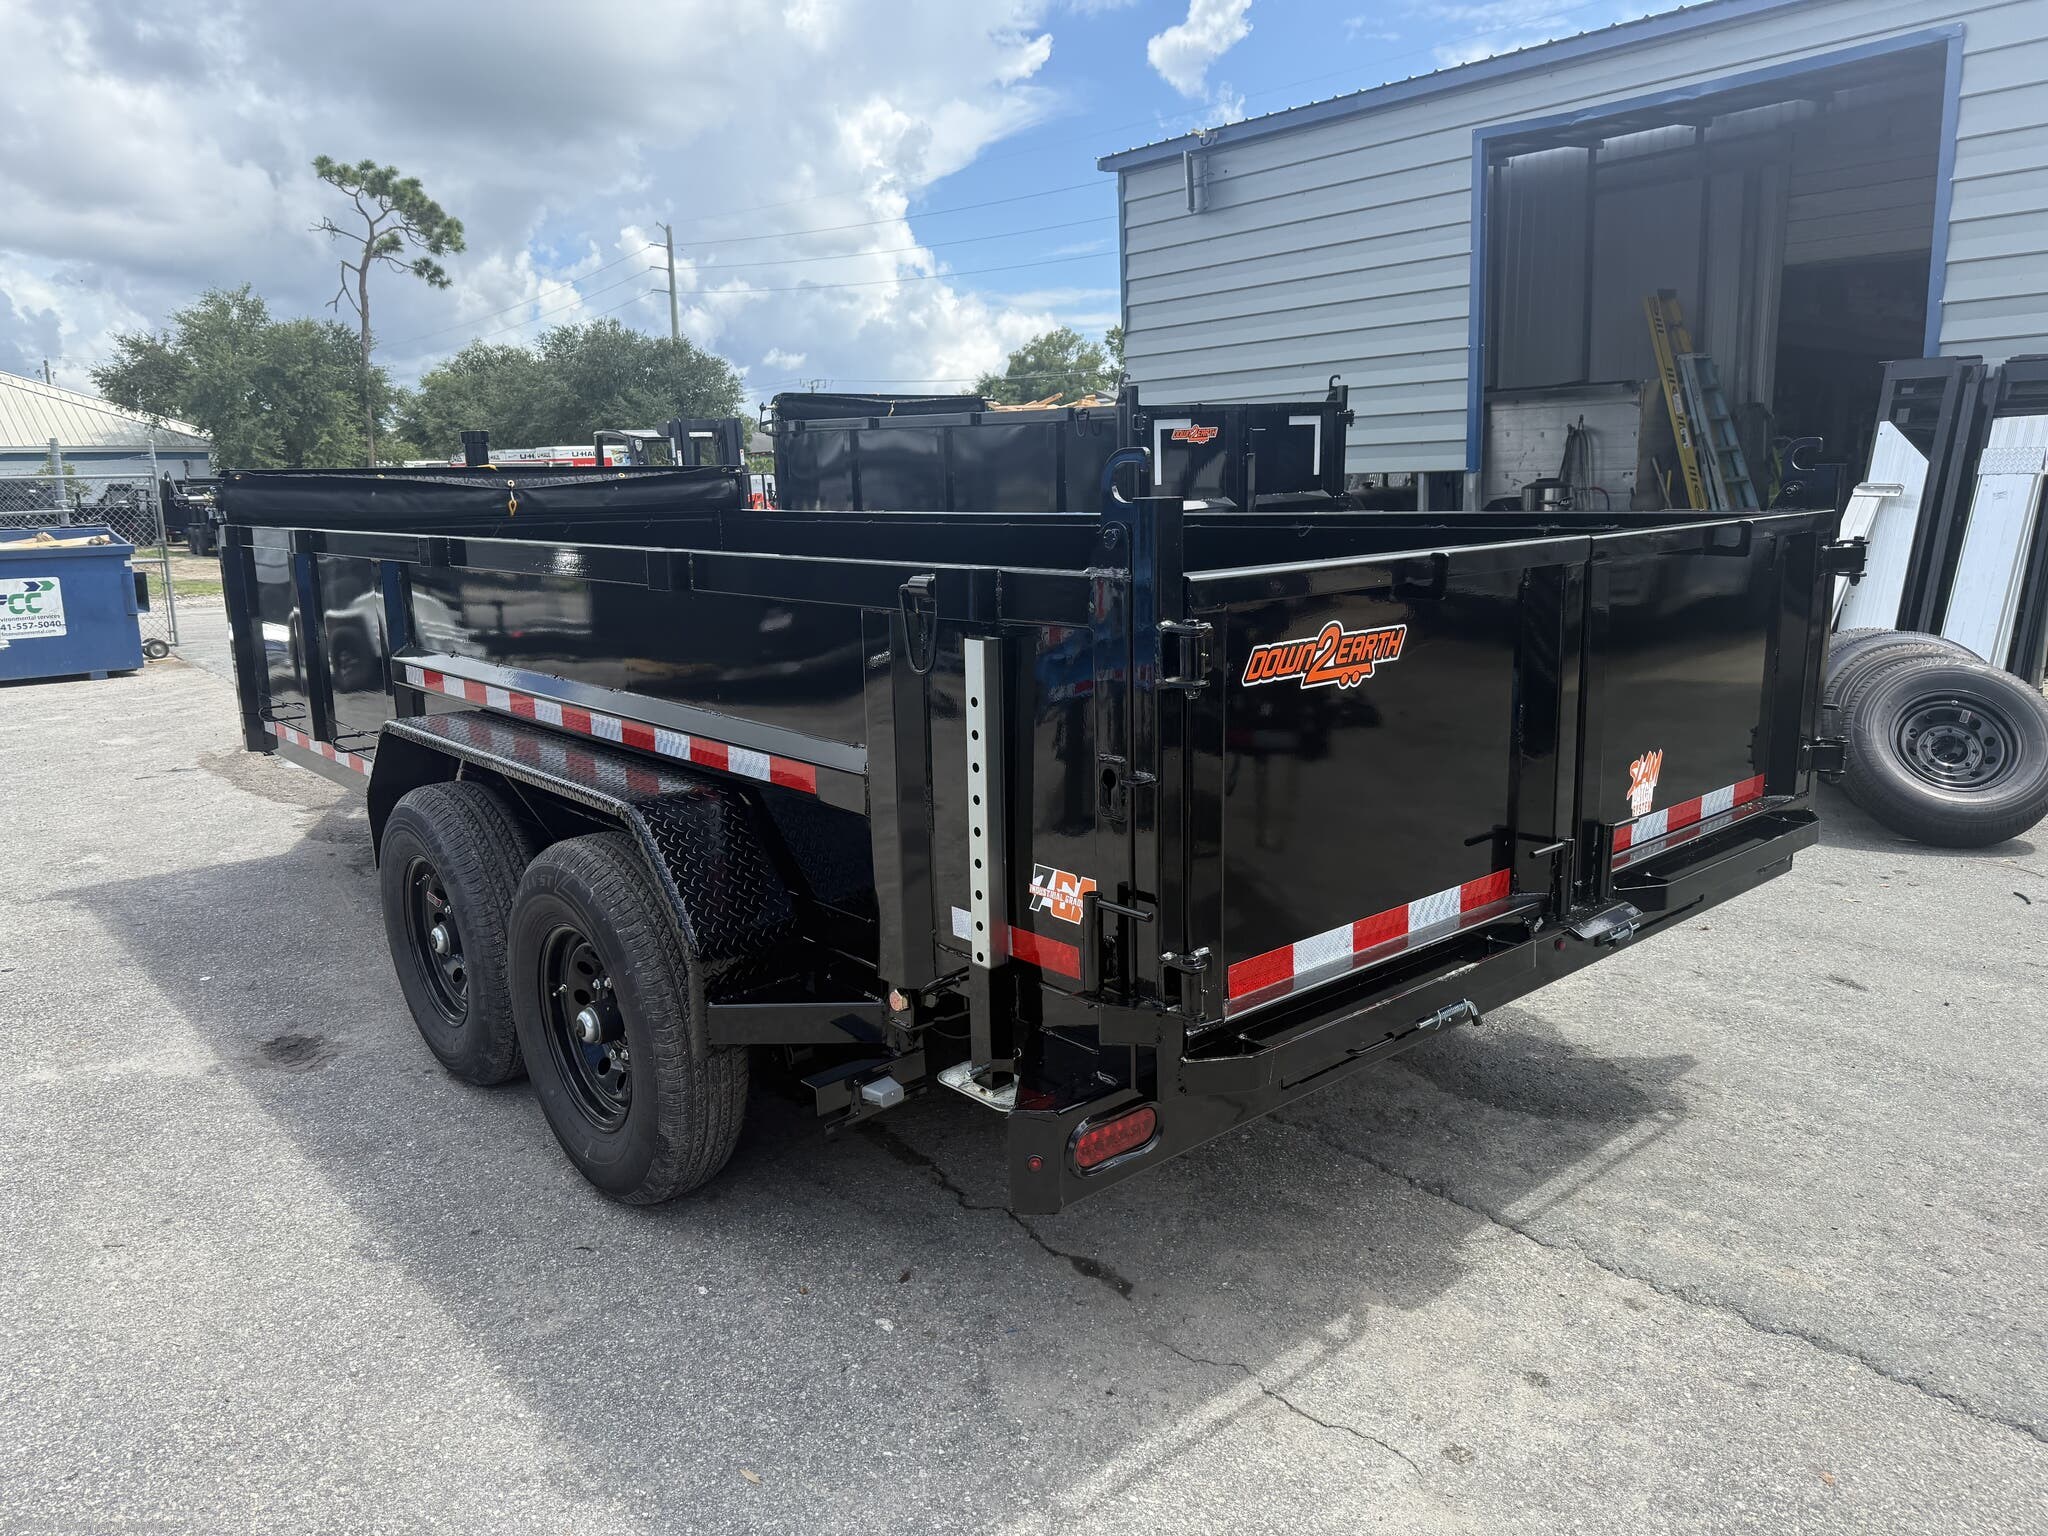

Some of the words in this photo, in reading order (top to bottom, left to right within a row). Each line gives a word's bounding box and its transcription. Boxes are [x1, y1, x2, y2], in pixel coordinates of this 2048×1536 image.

[1244, 624, 1405, 686] DOWN2EARTH
[1029, 884, 1064, 902] INDUSTRIAL
[1064, 895, 1083, 908] GRAD
